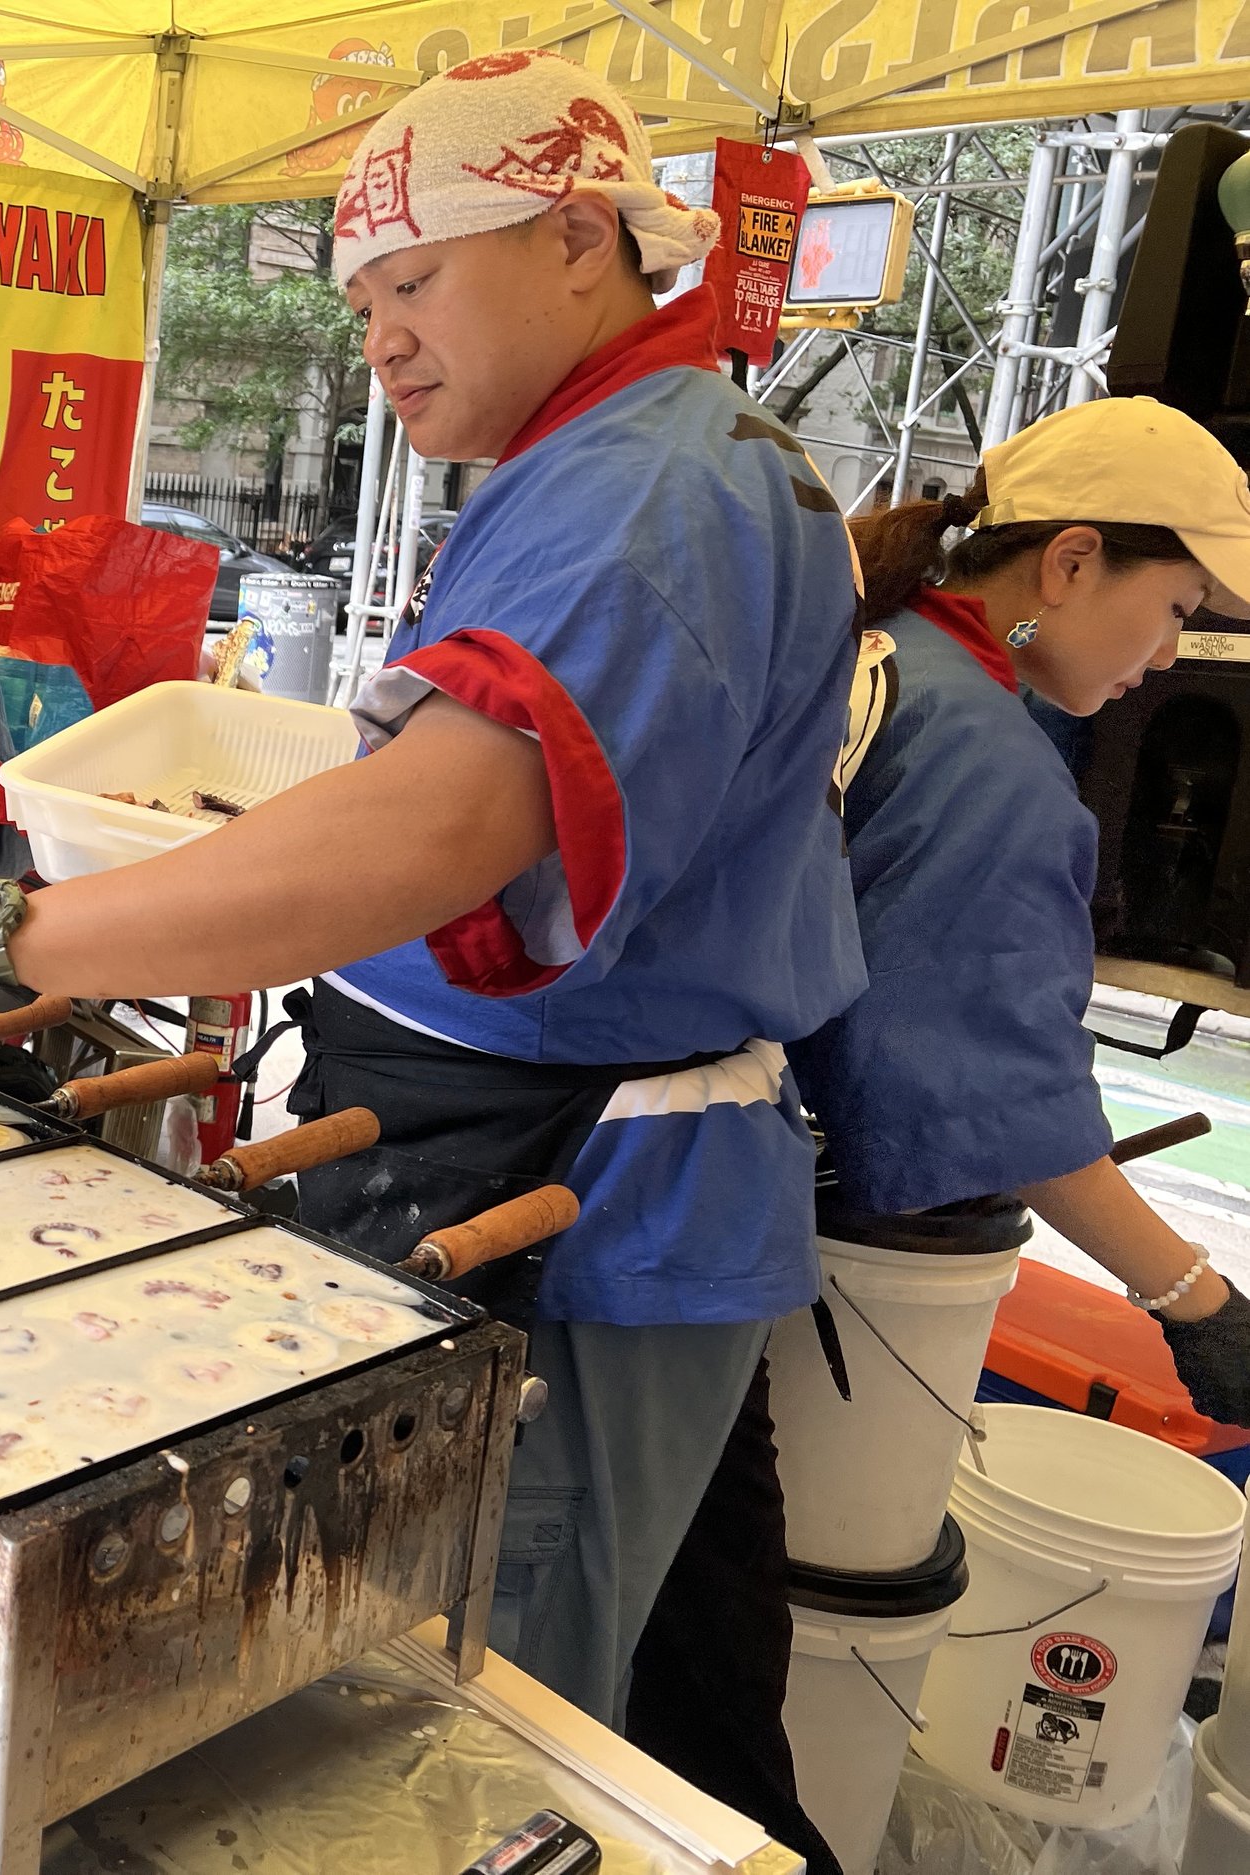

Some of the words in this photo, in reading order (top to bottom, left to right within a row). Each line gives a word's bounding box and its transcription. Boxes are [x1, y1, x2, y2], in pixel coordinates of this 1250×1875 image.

[741, 193, 794, 210] EMERGENCY
[752, 211, 779, 233] FIRE
[740, 230, 790, 258] BLANKET
[737, 278, 759, 293] PULL
[759, 282, 779, 297] TABS
[734, 289, 744, 301] TO
[745, 291, 780, 309] RELEASE
[41, 371, 85, 533] たこ
[1191, 642, 1235, 651] WASHING
[1200, 635, 1227, 644] HAND
[1199, 648, 1224, 657] ONLY
